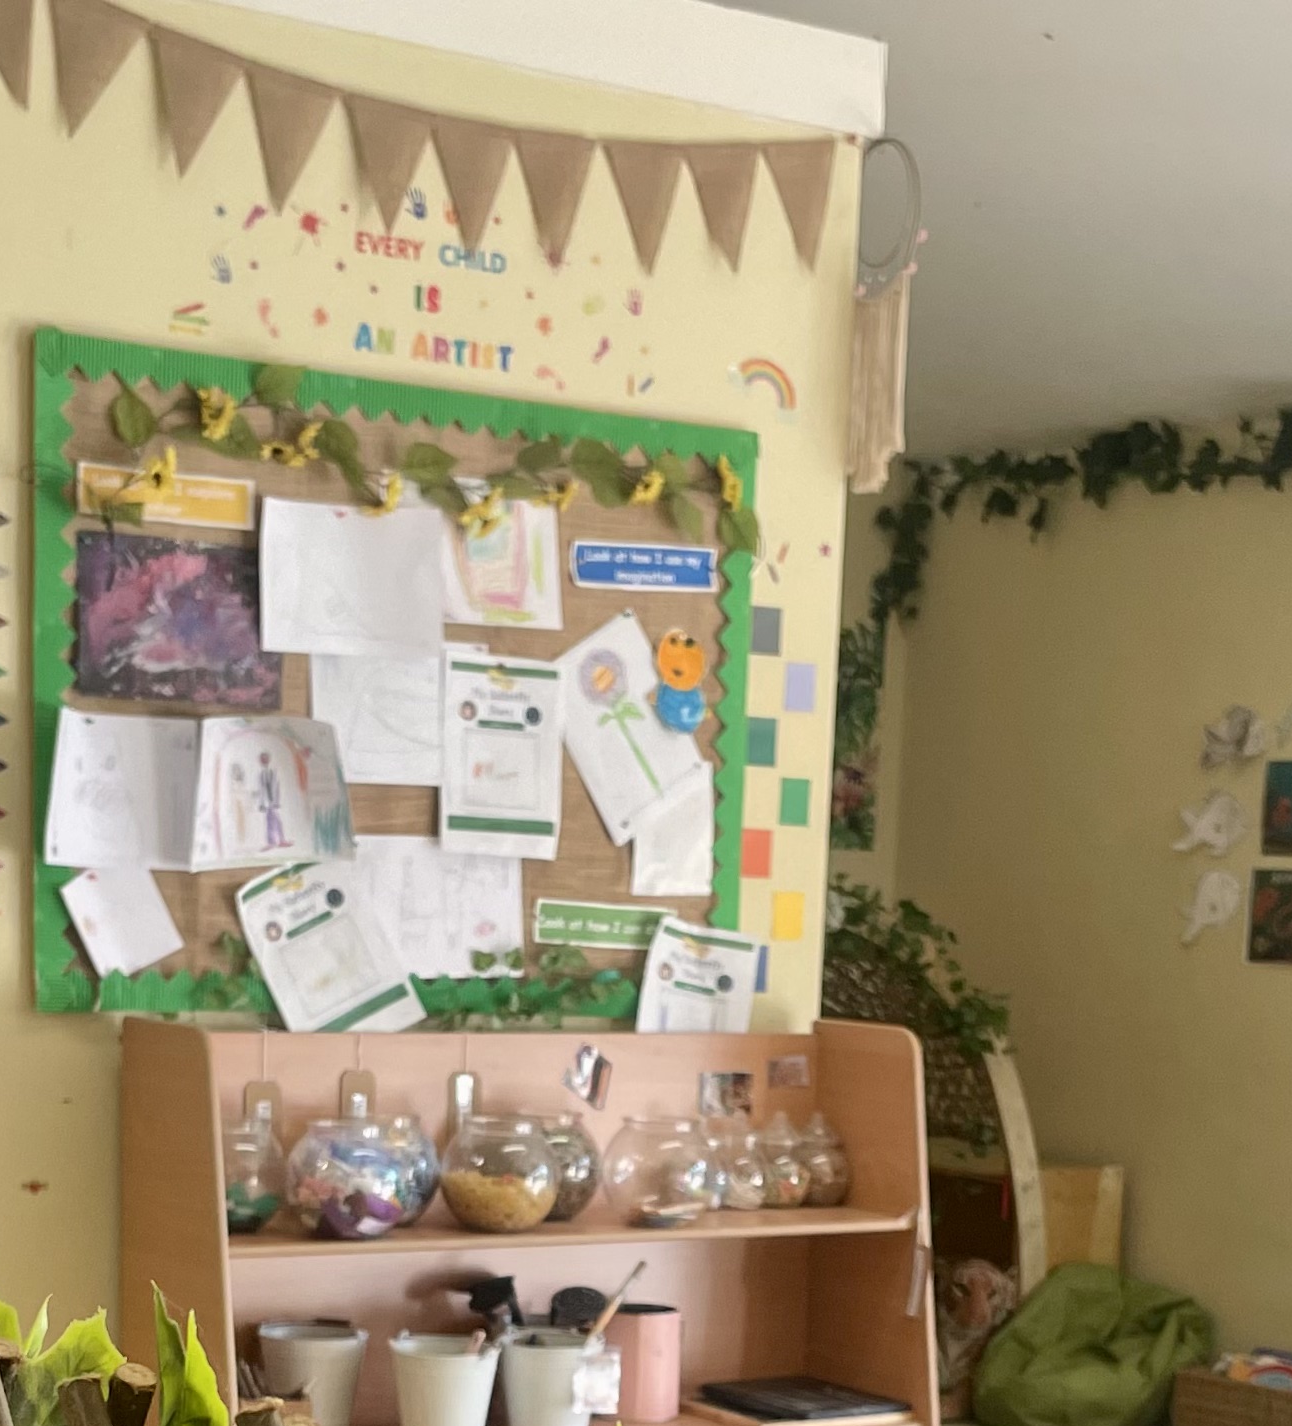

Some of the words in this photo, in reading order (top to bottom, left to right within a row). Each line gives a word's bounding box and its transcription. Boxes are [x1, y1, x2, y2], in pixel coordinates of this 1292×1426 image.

[354, 231, 426, 261] EVERY
[438, 244, 508, 274] CHILD
[413, 284, 442, 314] IS
[354, 322, 395, 355] AN
[410, 331, 514, 373] ARTIST
